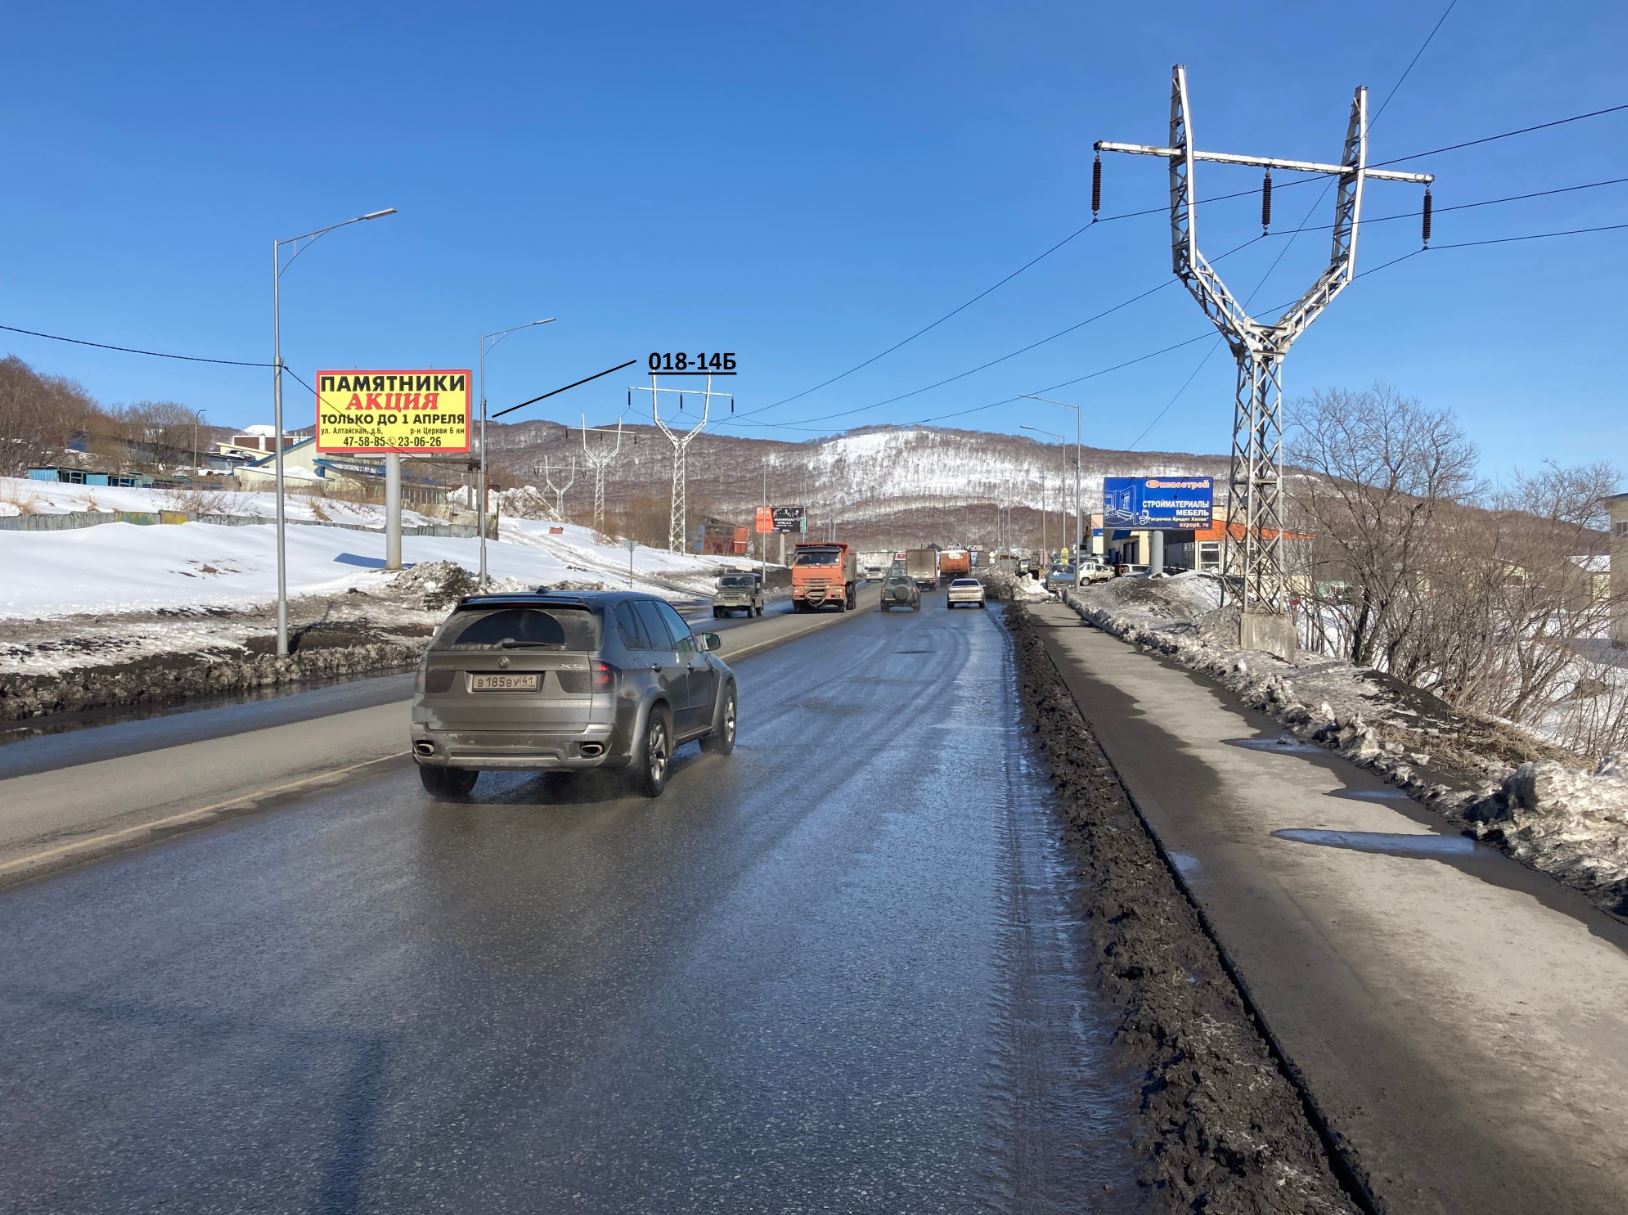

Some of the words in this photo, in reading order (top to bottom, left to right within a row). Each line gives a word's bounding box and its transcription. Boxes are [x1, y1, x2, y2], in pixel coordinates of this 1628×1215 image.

[321, 376, 465, 392] ПАМЯТНИКИ
[345, 393, 440, 412] АКЦИЯ
[321, 414, 374, 424] ТОЛЬКО
[377, 414, 398, 425] ДО
[402, 414, 408, 424] 1
[413, 414, 465, 424] АПРЕЛЯ
[423, 427, 448, 435] Церкви
[343, 437, 386, 446] 47-58-85
[398, 437, 442, 446] 23-06-26
[1142, 500, 1209, 508] СТРОЙМАТЕРИАЛЫ
